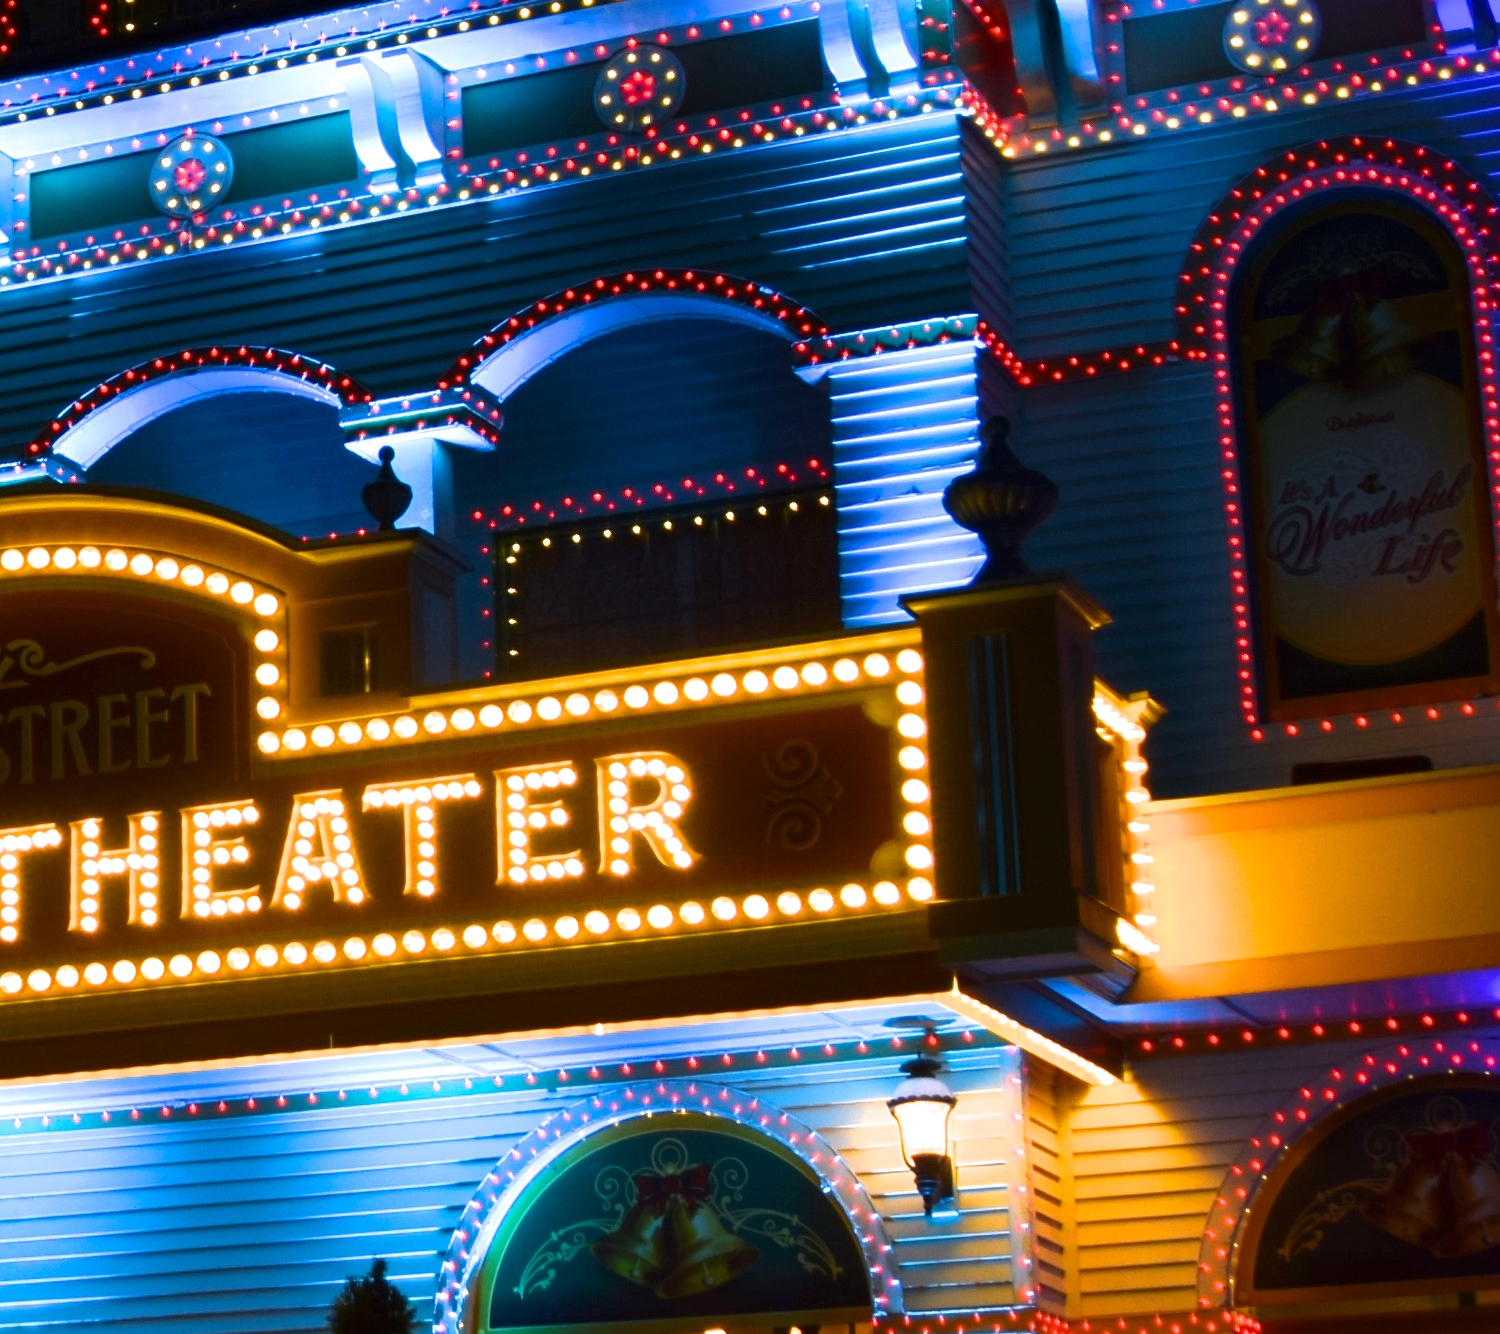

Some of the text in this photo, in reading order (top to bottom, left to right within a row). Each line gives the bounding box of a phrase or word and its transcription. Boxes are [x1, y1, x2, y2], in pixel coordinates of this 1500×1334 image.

[1314, 474, 1339, 505] A
[1265, 462, 1474, 577] Wonderful
[1370, 528, 1465, 585] Life
